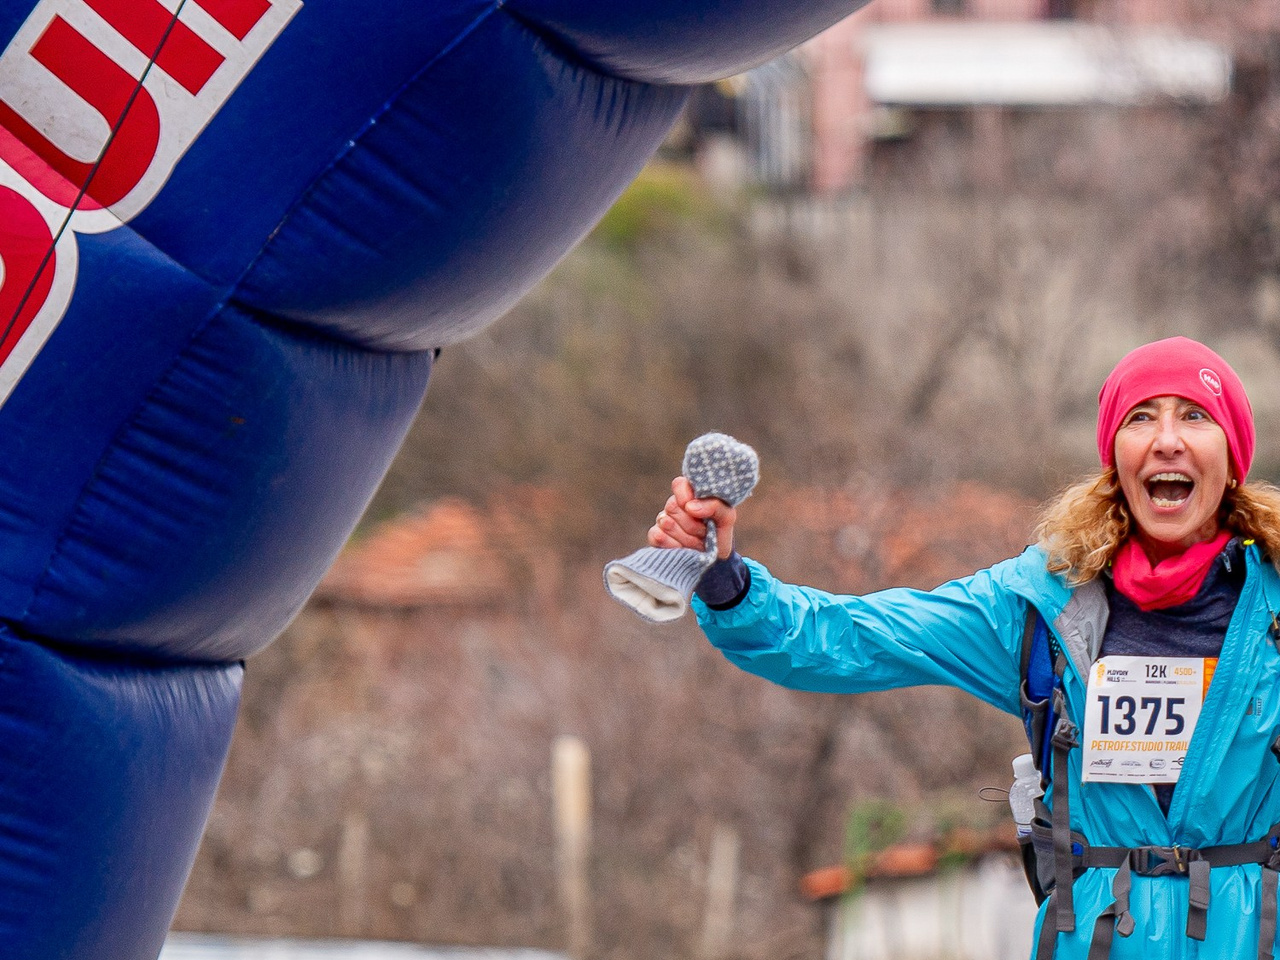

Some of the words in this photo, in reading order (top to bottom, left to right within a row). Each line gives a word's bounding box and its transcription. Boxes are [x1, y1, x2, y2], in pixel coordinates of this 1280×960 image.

[1145, 664, 1167, 678] 12K
[1097, 695, 1186, 736] 1375
[1165, 741, 1189, 752] TRAIL
